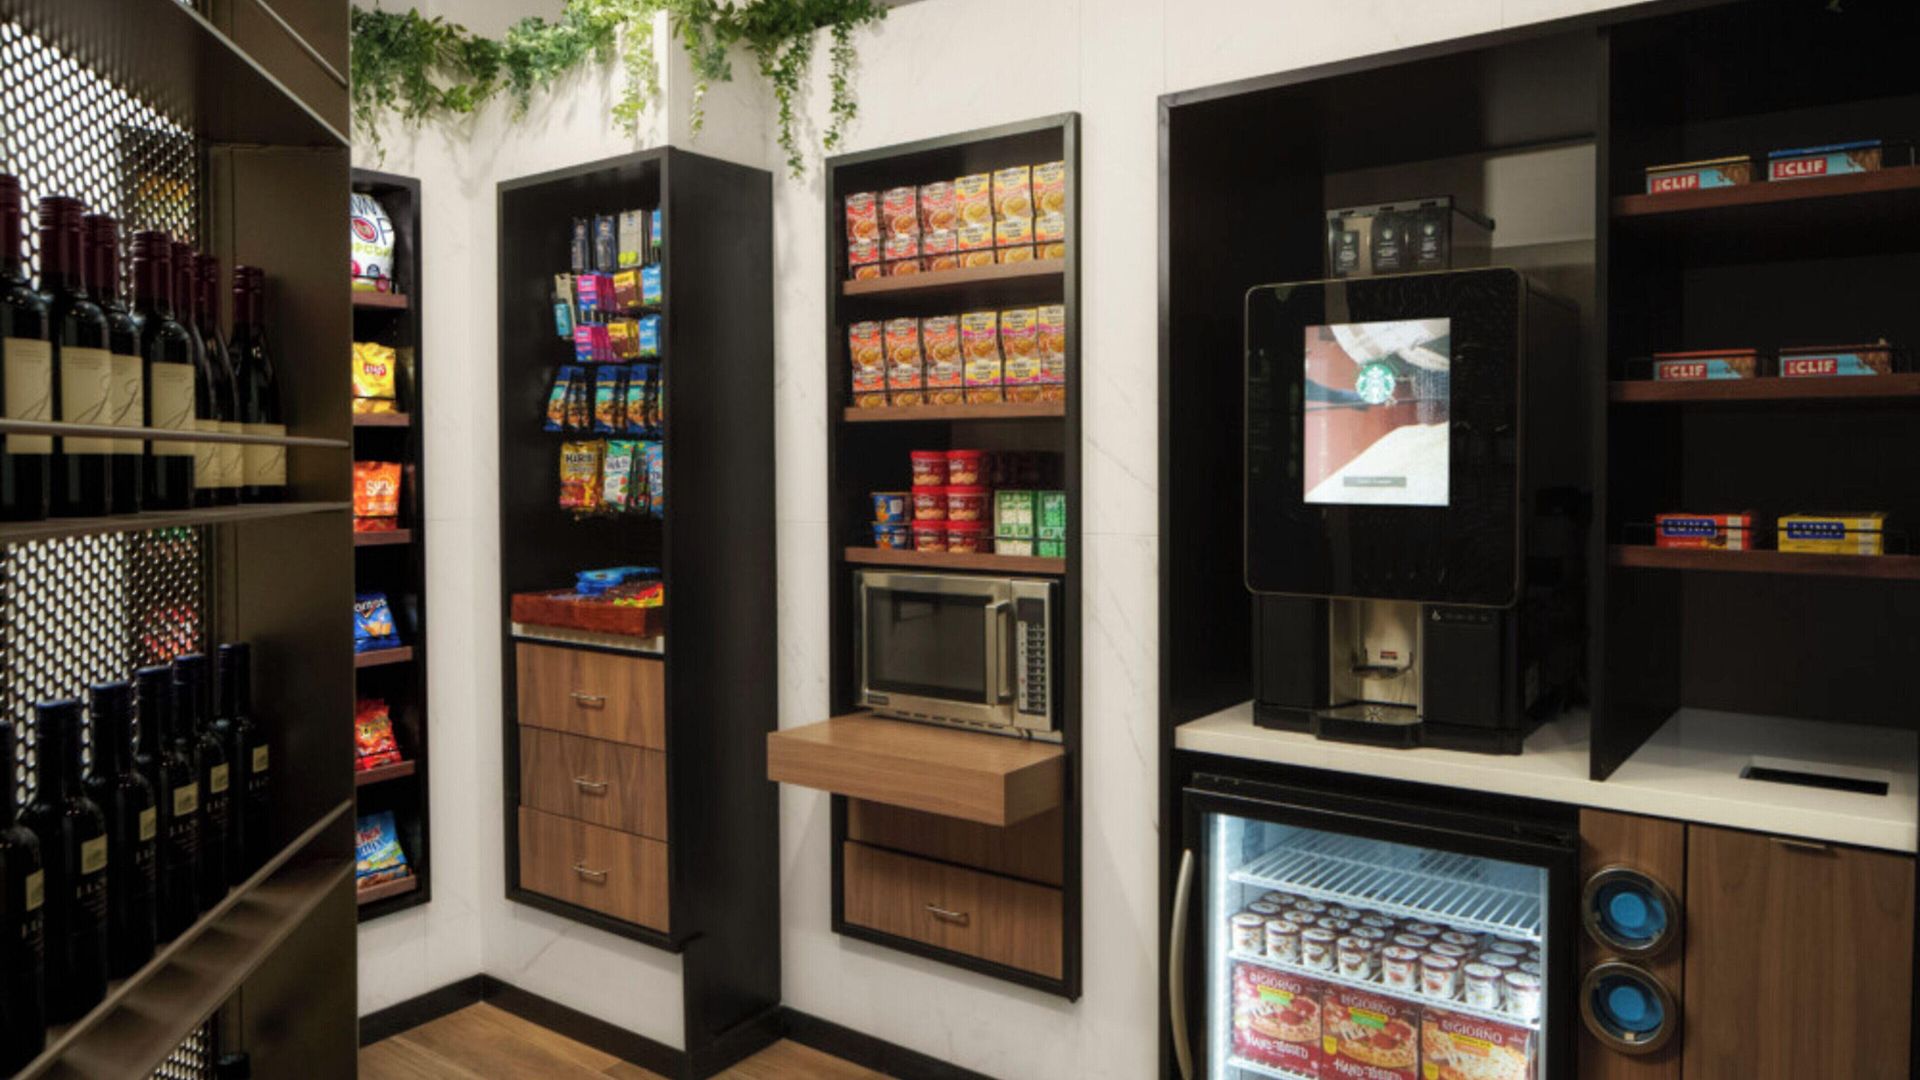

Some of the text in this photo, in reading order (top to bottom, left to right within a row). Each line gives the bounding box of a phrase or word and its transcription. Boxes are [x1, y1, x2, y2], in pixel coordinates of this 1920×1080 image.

[1785, 160, 1824, 175] CLIF
[1662, 174, 1697, 191] CLIF
[1669, 364, 1705, 378] CLIF
[1795, 359, 1834, 374] CLIF
